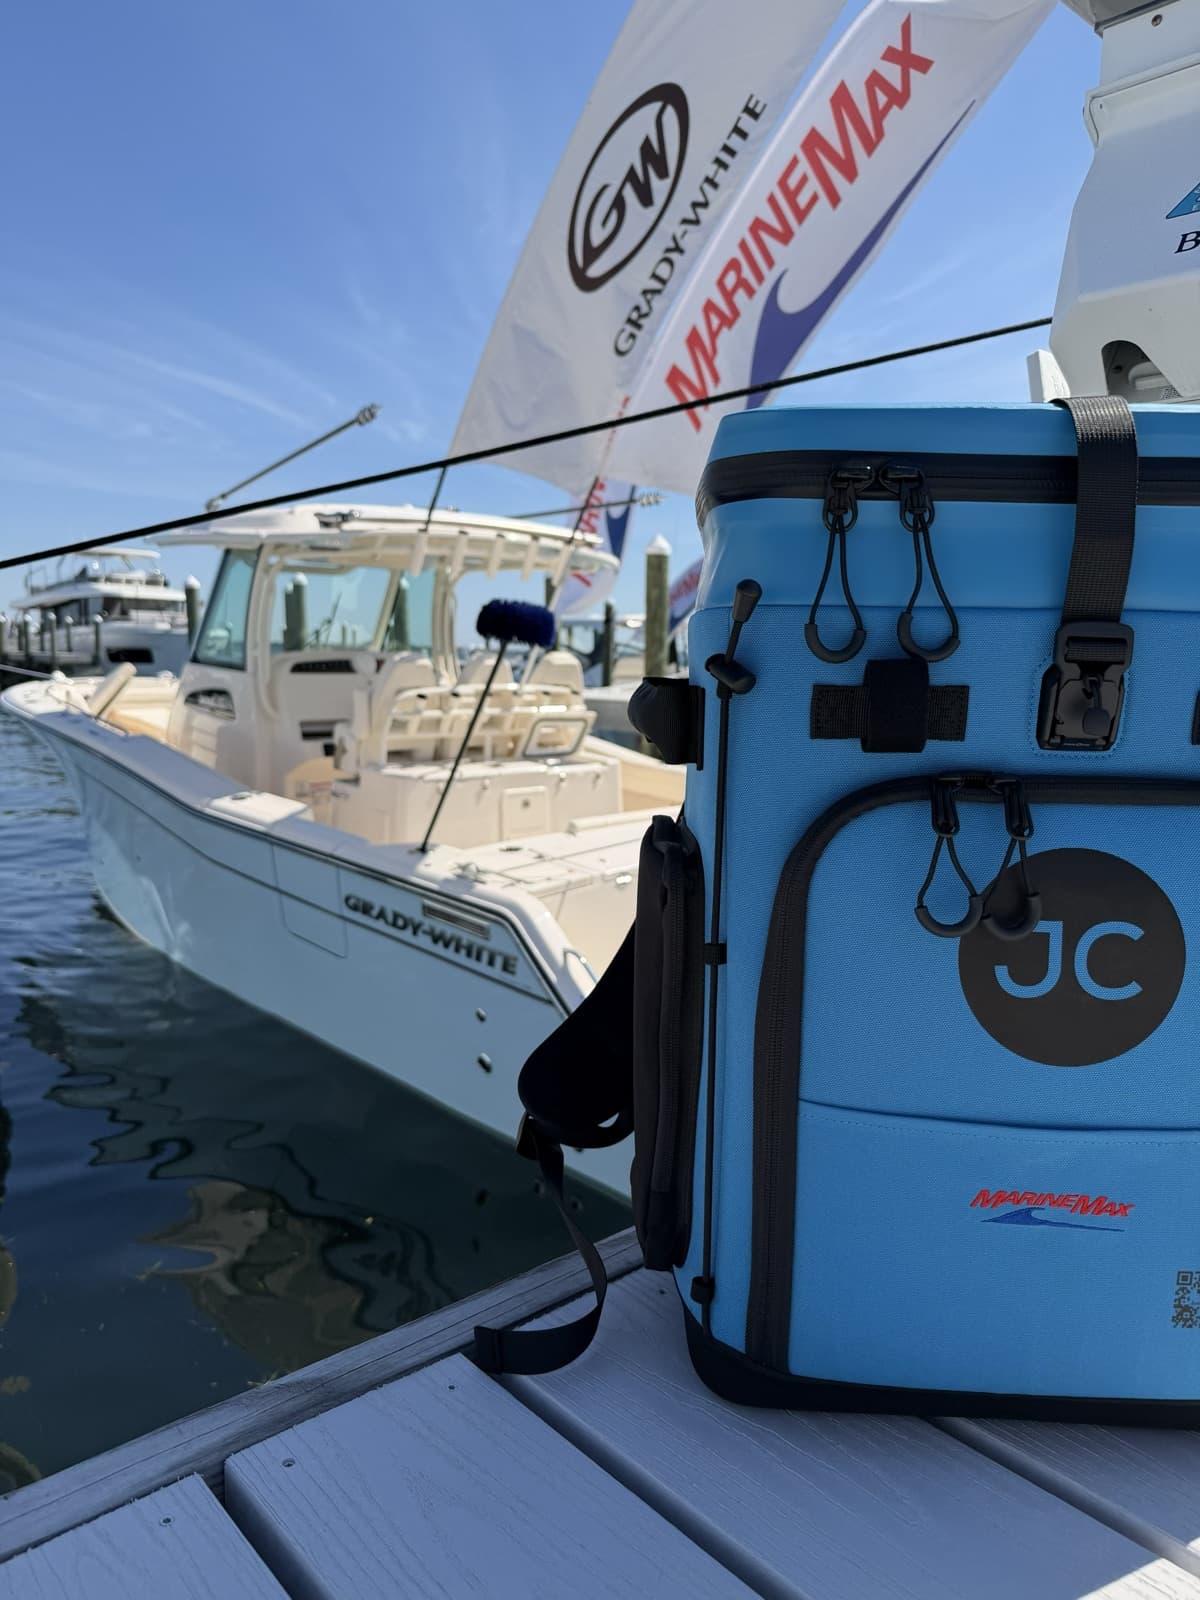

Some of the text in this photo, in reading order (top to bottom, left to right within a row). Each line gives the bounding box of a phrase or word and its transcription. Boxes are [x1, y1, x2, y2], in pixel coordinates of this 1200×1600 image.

[613, 93, 768, 357] GRADY-WHITE
[343, 893, 518, 976] GRADY-WHITE
[994, 920, 1145, 1000] JC
